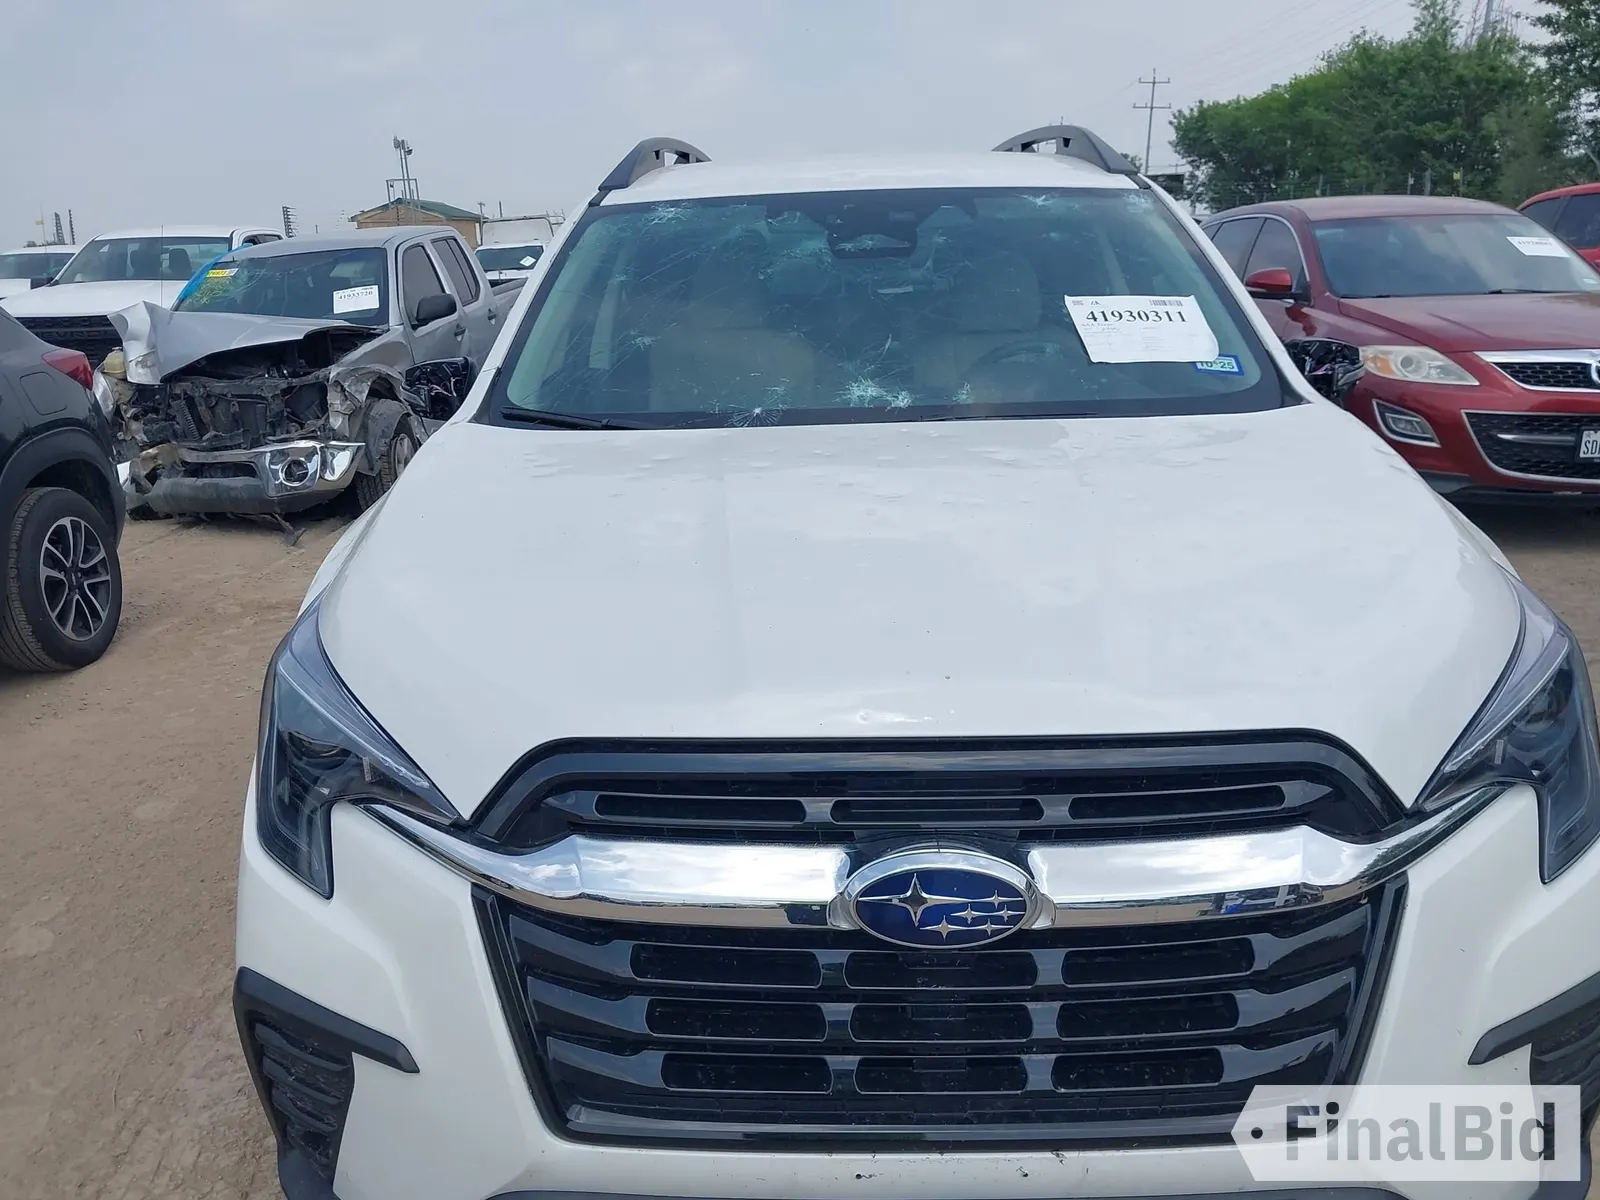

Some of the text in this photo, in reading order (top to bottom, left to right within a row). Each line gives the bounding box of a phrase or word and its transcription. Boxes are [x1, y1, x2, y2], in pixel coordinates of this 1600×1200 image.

[1086, 309, 1188, 323] 41930311
[1219, 361, 1235, 370] 25
[1583, 440, 1600, 455] SD
